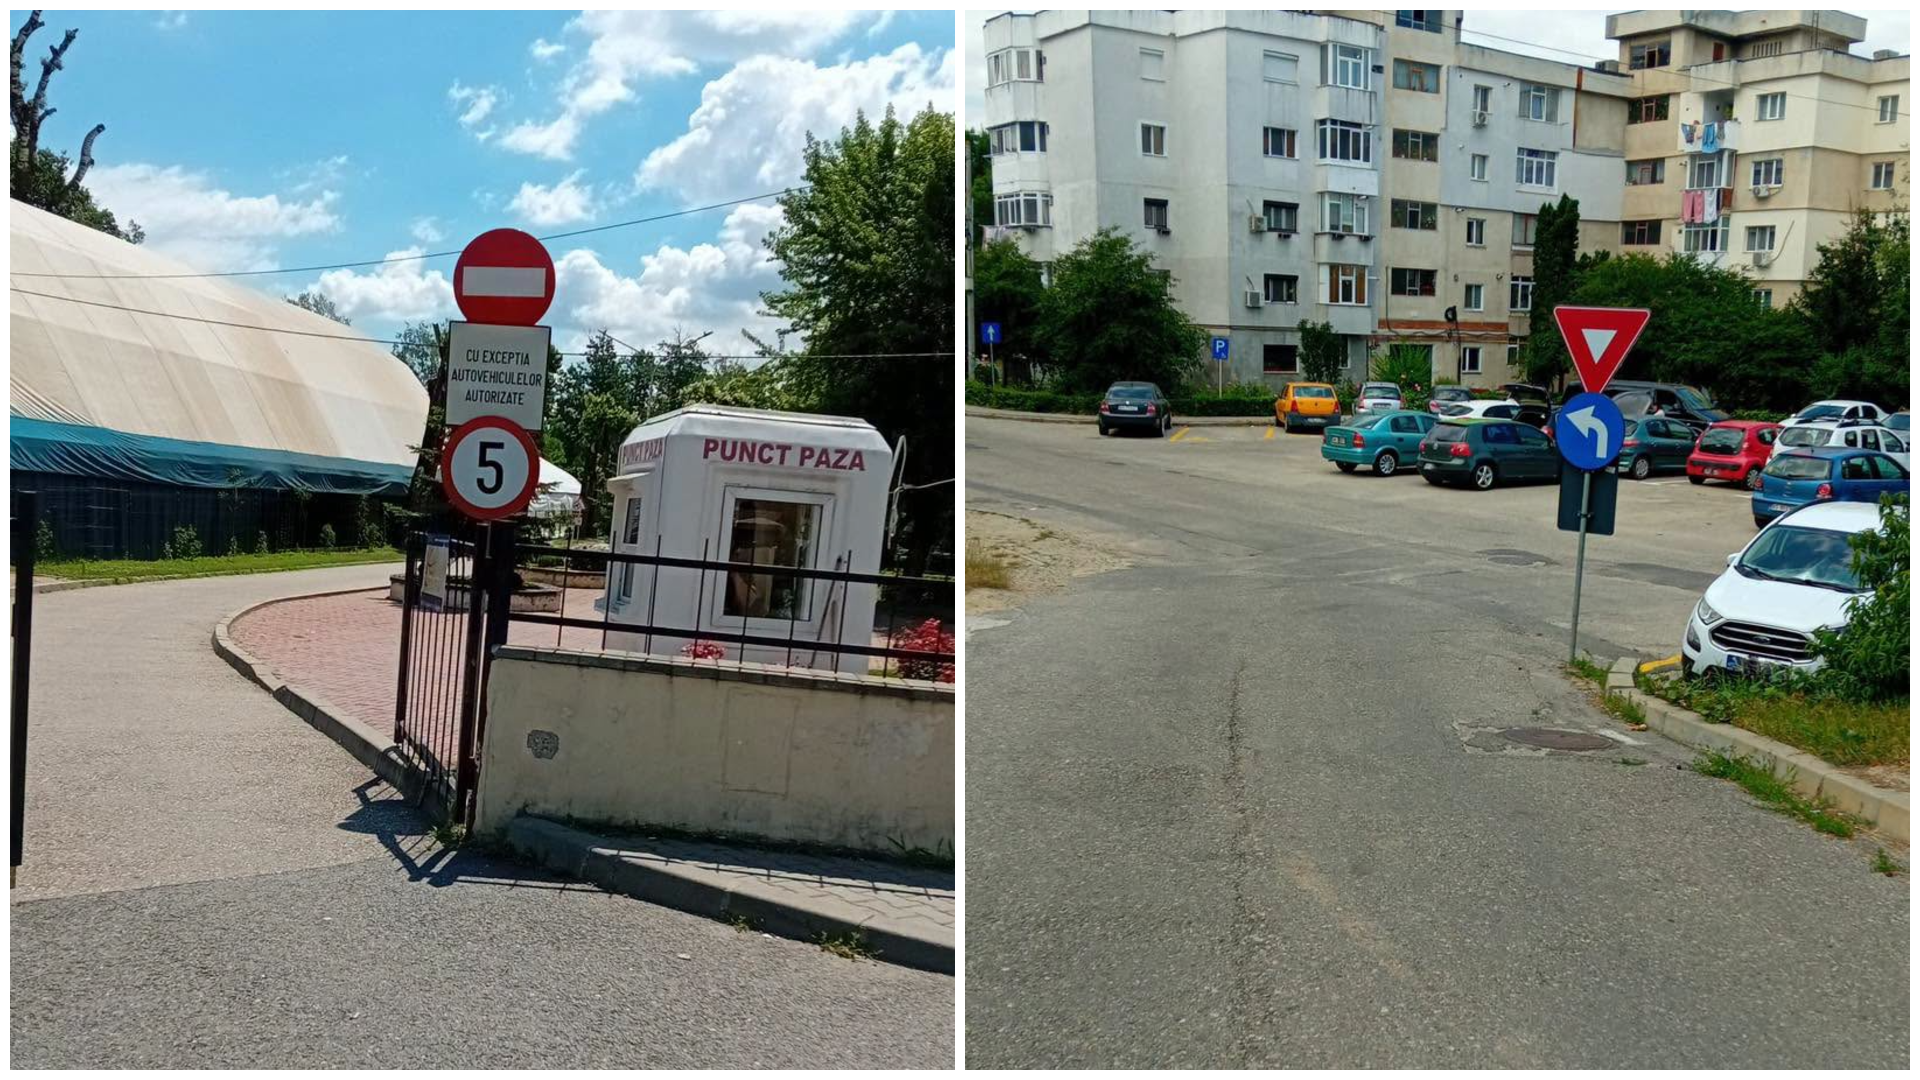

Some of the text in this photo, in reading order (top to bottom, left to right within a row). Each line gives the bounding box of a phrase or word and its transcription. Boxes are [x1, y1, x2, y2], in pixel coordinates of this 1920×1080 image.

[1216, 340, 1226, 353] P
[466, 349, 530, 365] CU EXCEPTIA
[451, 368, 543, 387] AUTOVEHICULELOR
[465, 389, 525, 405] AUTORIZATE
[703, 438, 865, 471] PUNCT PAZA
[476, 441, 505, 495] 5
